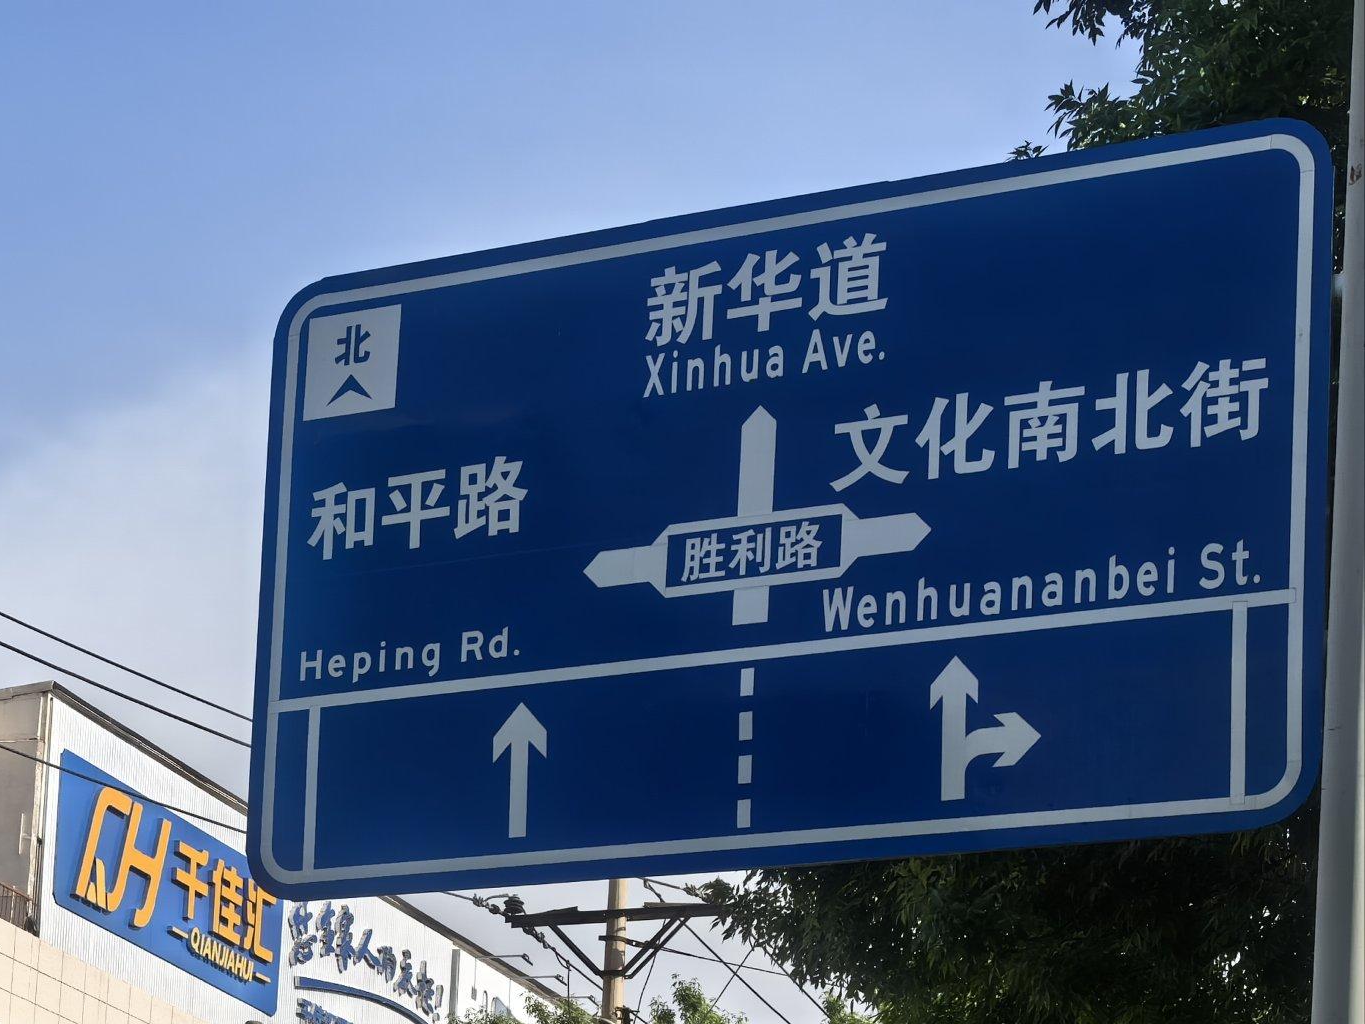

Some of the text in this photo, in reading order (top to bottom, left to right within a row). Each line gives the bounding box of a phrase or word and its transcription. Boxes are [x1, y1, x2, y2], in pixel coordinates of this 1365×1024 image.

[646, 234, 888, 346] 新华道
[335, 324, 371, 366] 北
[644, 329, 885, 397] Xinhua Ave.
[830, 352, 1268, 491] 文化南北街
[308, 457, 527, 559] 和平路
[682, 522, 823, 582] 胜利路
[823, 540, 1262, 632] Wenhuananbei St.
[300, 628, 520, 682] Heping Rd.
[173, 839, 275, 964] 千佳汇
[190, 923, 254, 983] QIANJIAHUI
